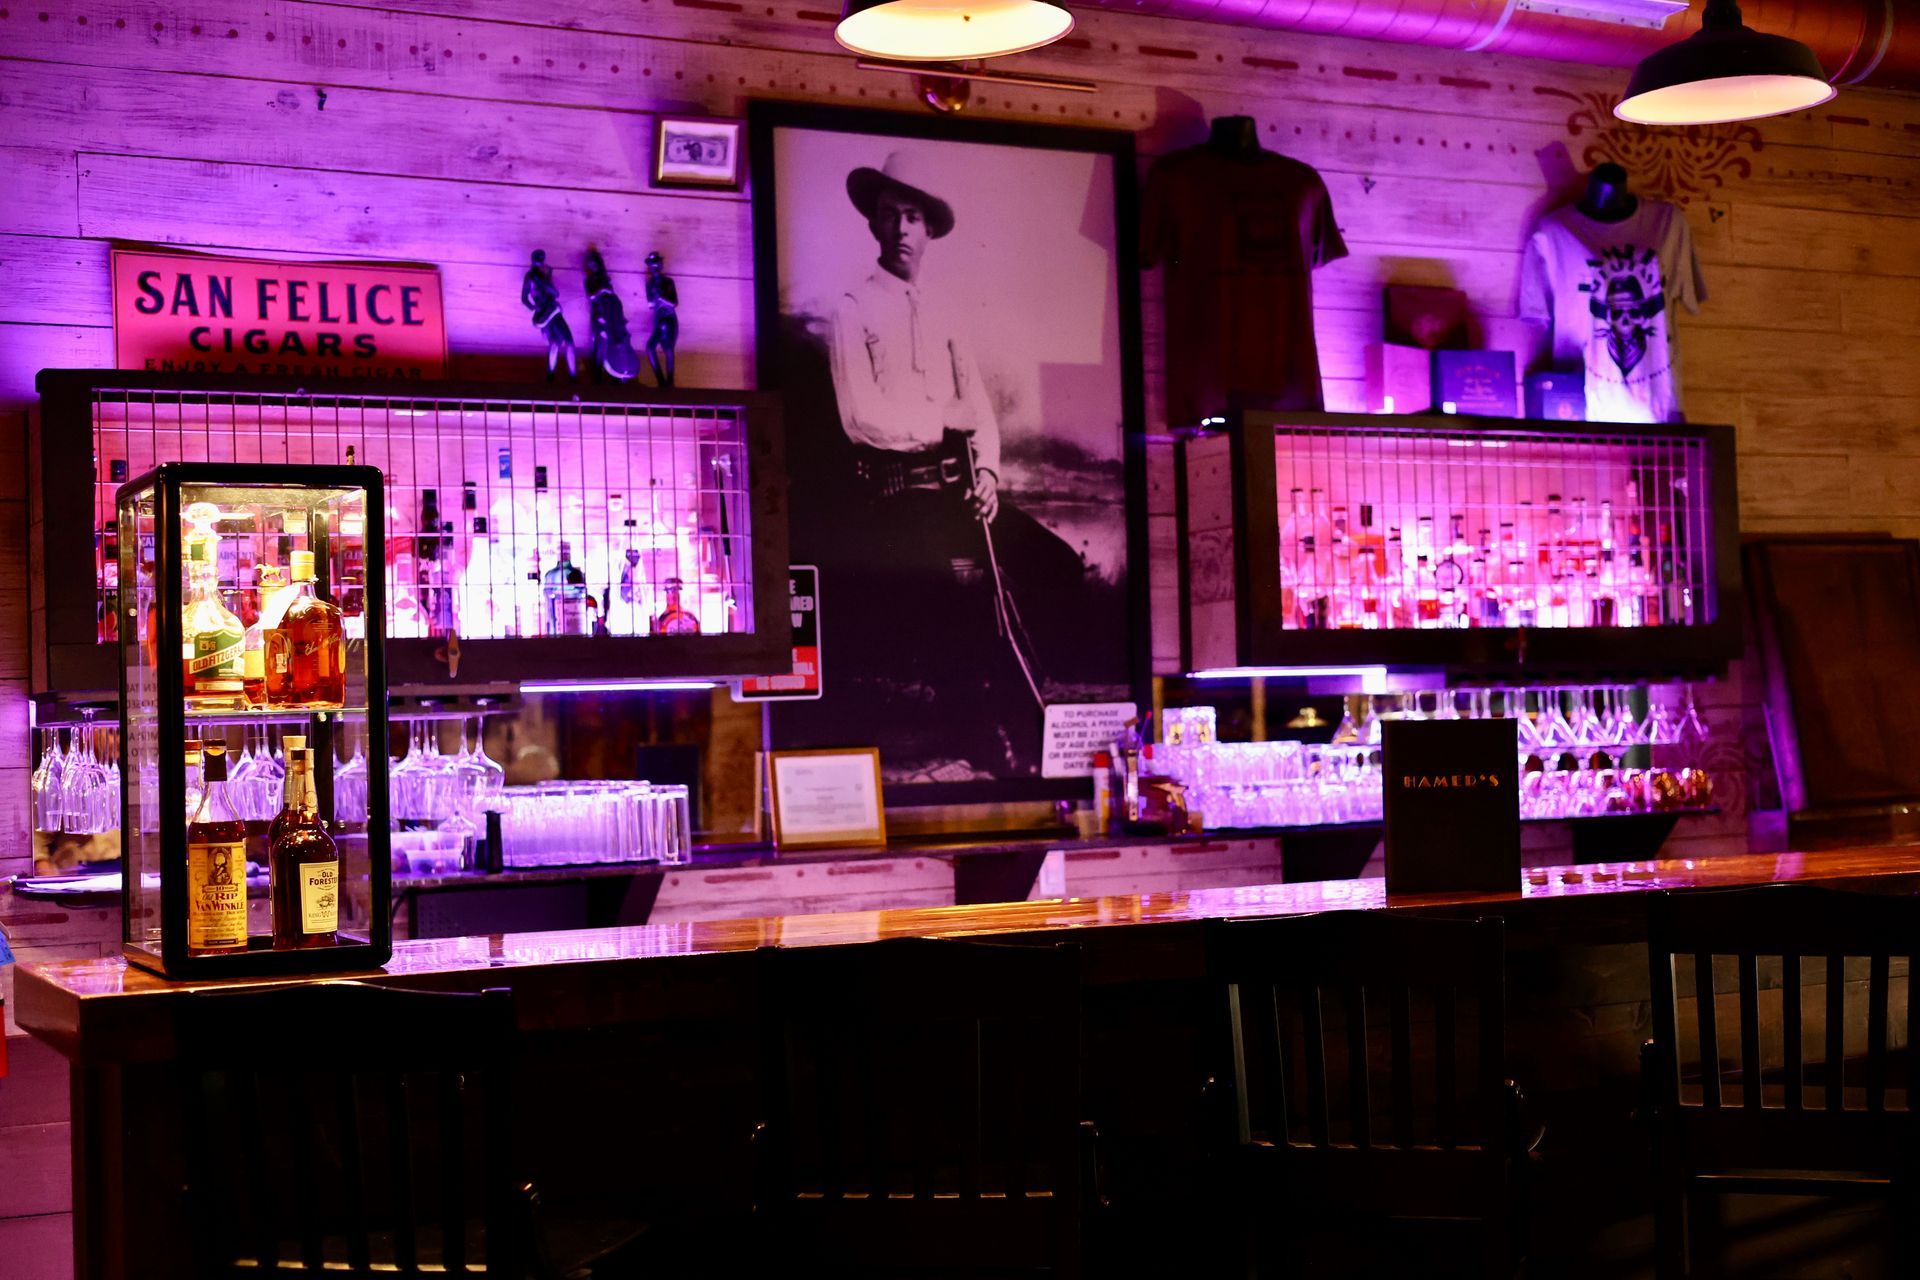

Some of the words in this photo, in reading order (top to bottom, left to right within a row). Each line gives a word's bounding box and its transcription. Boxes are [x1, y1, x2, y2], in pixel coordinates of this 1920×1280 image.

[135, 270, 234, 318] SAN
[256, 278, 425, 326] FELICE
[189, 326, 377, 359] CIGARS
[144, 358, 220, 374] ENJOY
[1077, 710, 1119, 718] PURCHASE
[1051, 721, 1088, 729] ALCOHOL
[1054, 731, 1075, 739] MUST
[1063, 761, 1084, 769] DATE
[1403, 774, 1499, 788] HAMER'S
[215, 892, 238, 900] RIP
[195, 900, 211, 911] VAN
[211, 900, 244, 911] WINKLE
